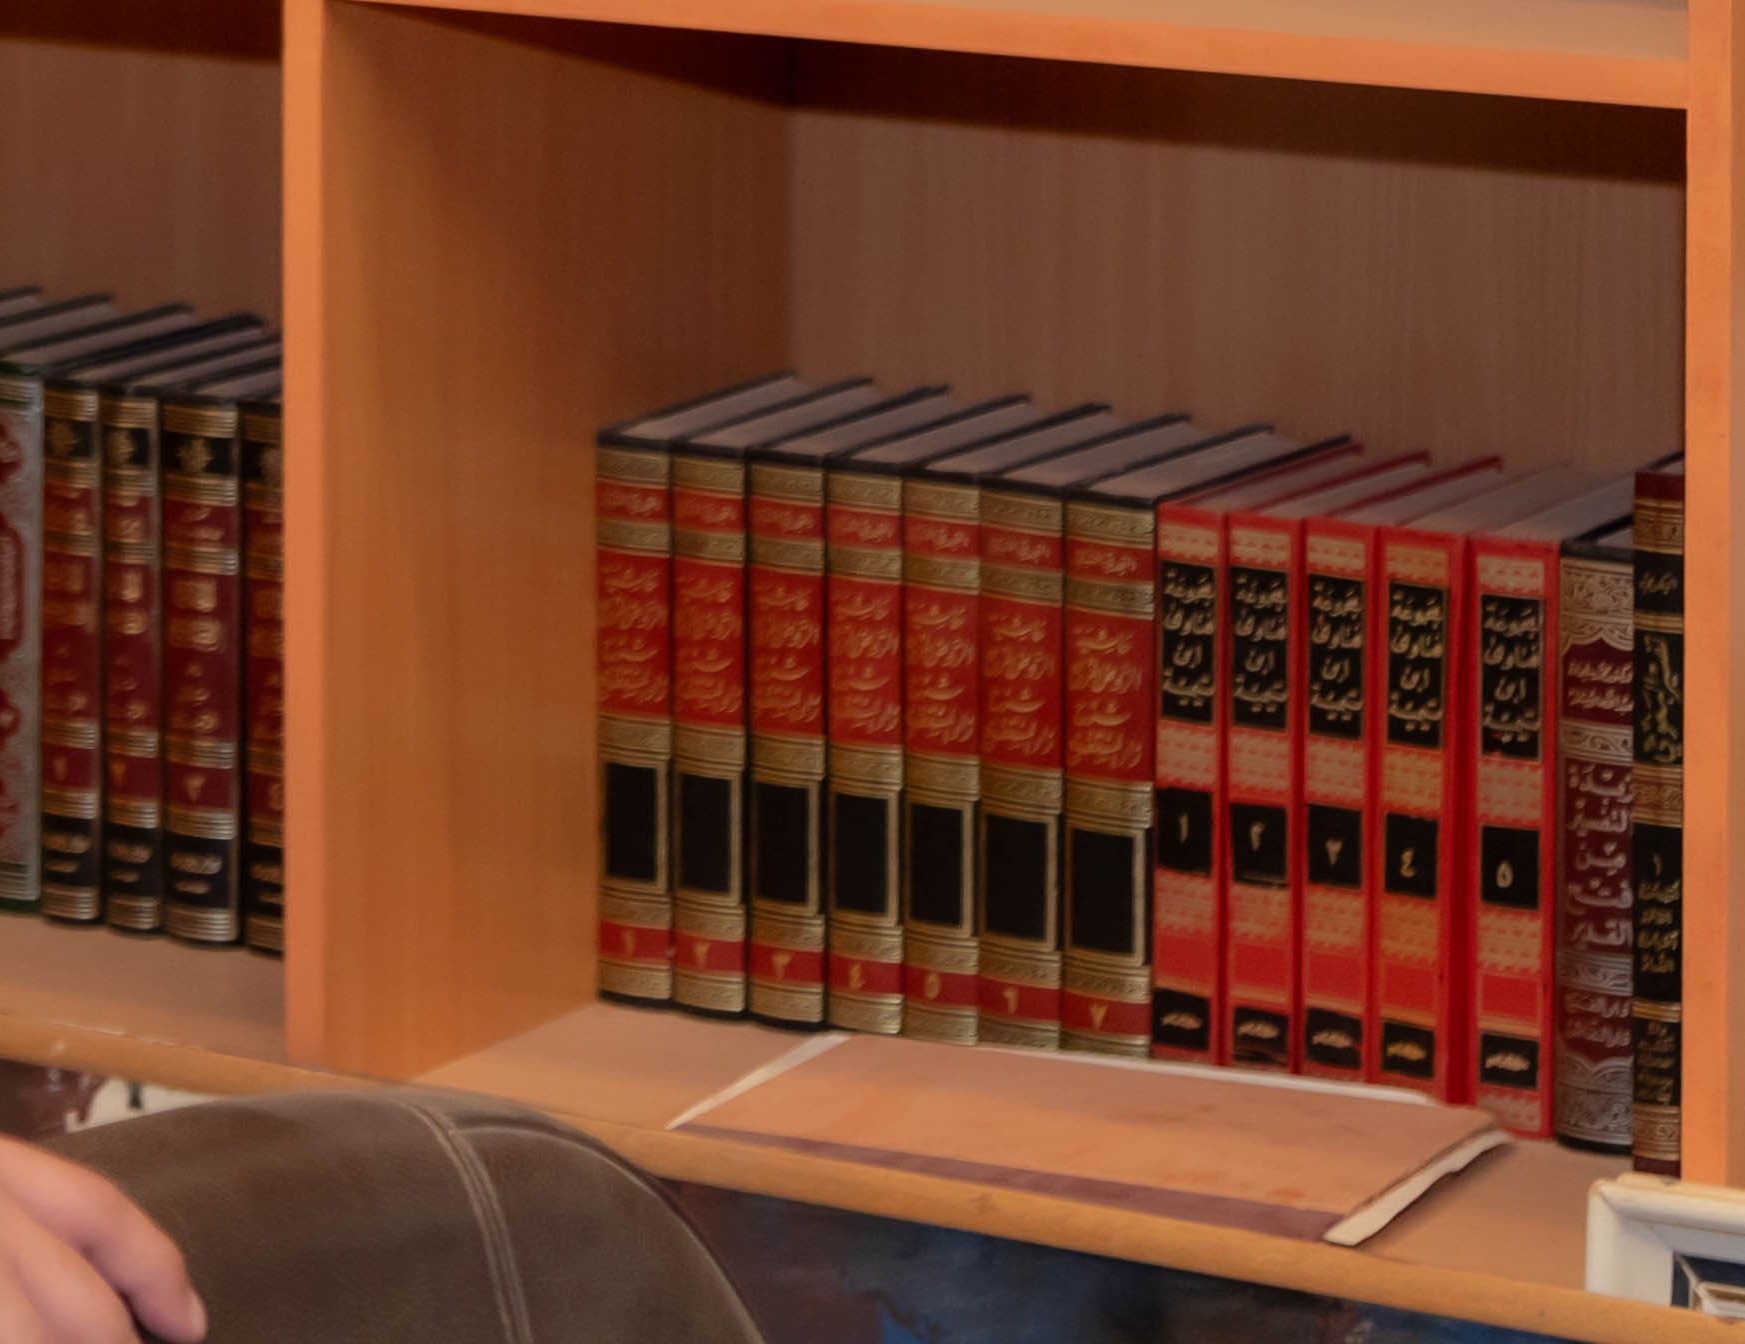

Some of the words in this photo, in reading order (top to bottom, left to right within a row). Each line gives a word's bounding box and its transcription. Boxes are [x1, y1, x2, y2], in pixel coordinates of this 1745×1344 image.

[1178, 812, 1189, 845] ١
[1248, 820, 1266, 852] ٢
[1399, 846, 1417, 879] ٤
[1495, 859, 1514, 889] ٥
